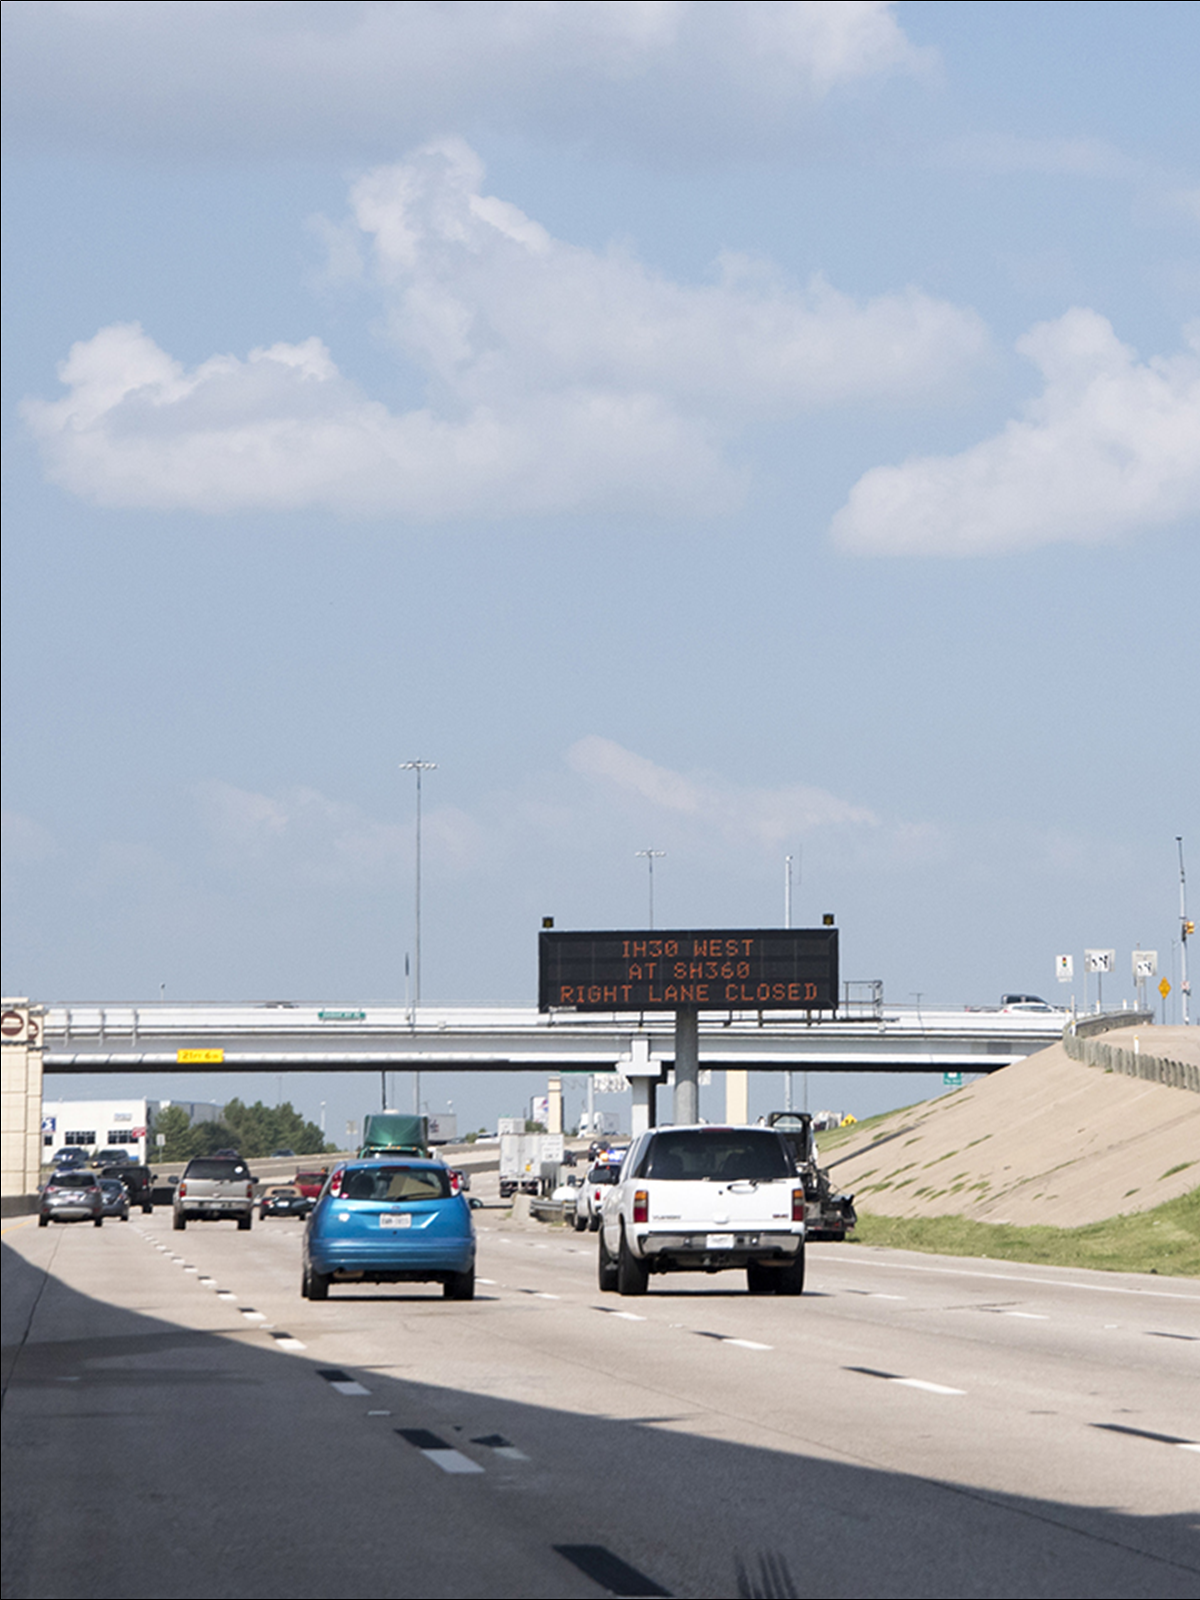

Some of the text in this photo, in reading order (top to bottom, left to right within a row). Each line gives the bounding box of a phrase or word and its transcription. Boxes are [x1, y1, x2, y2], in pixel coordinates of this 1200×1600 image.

[622, 939, 754, 958] IH30 WEST
[628, 961, 750, 980] AT SH360
[560, 982, 817, 1003] RIGHT LANE CLOSED
